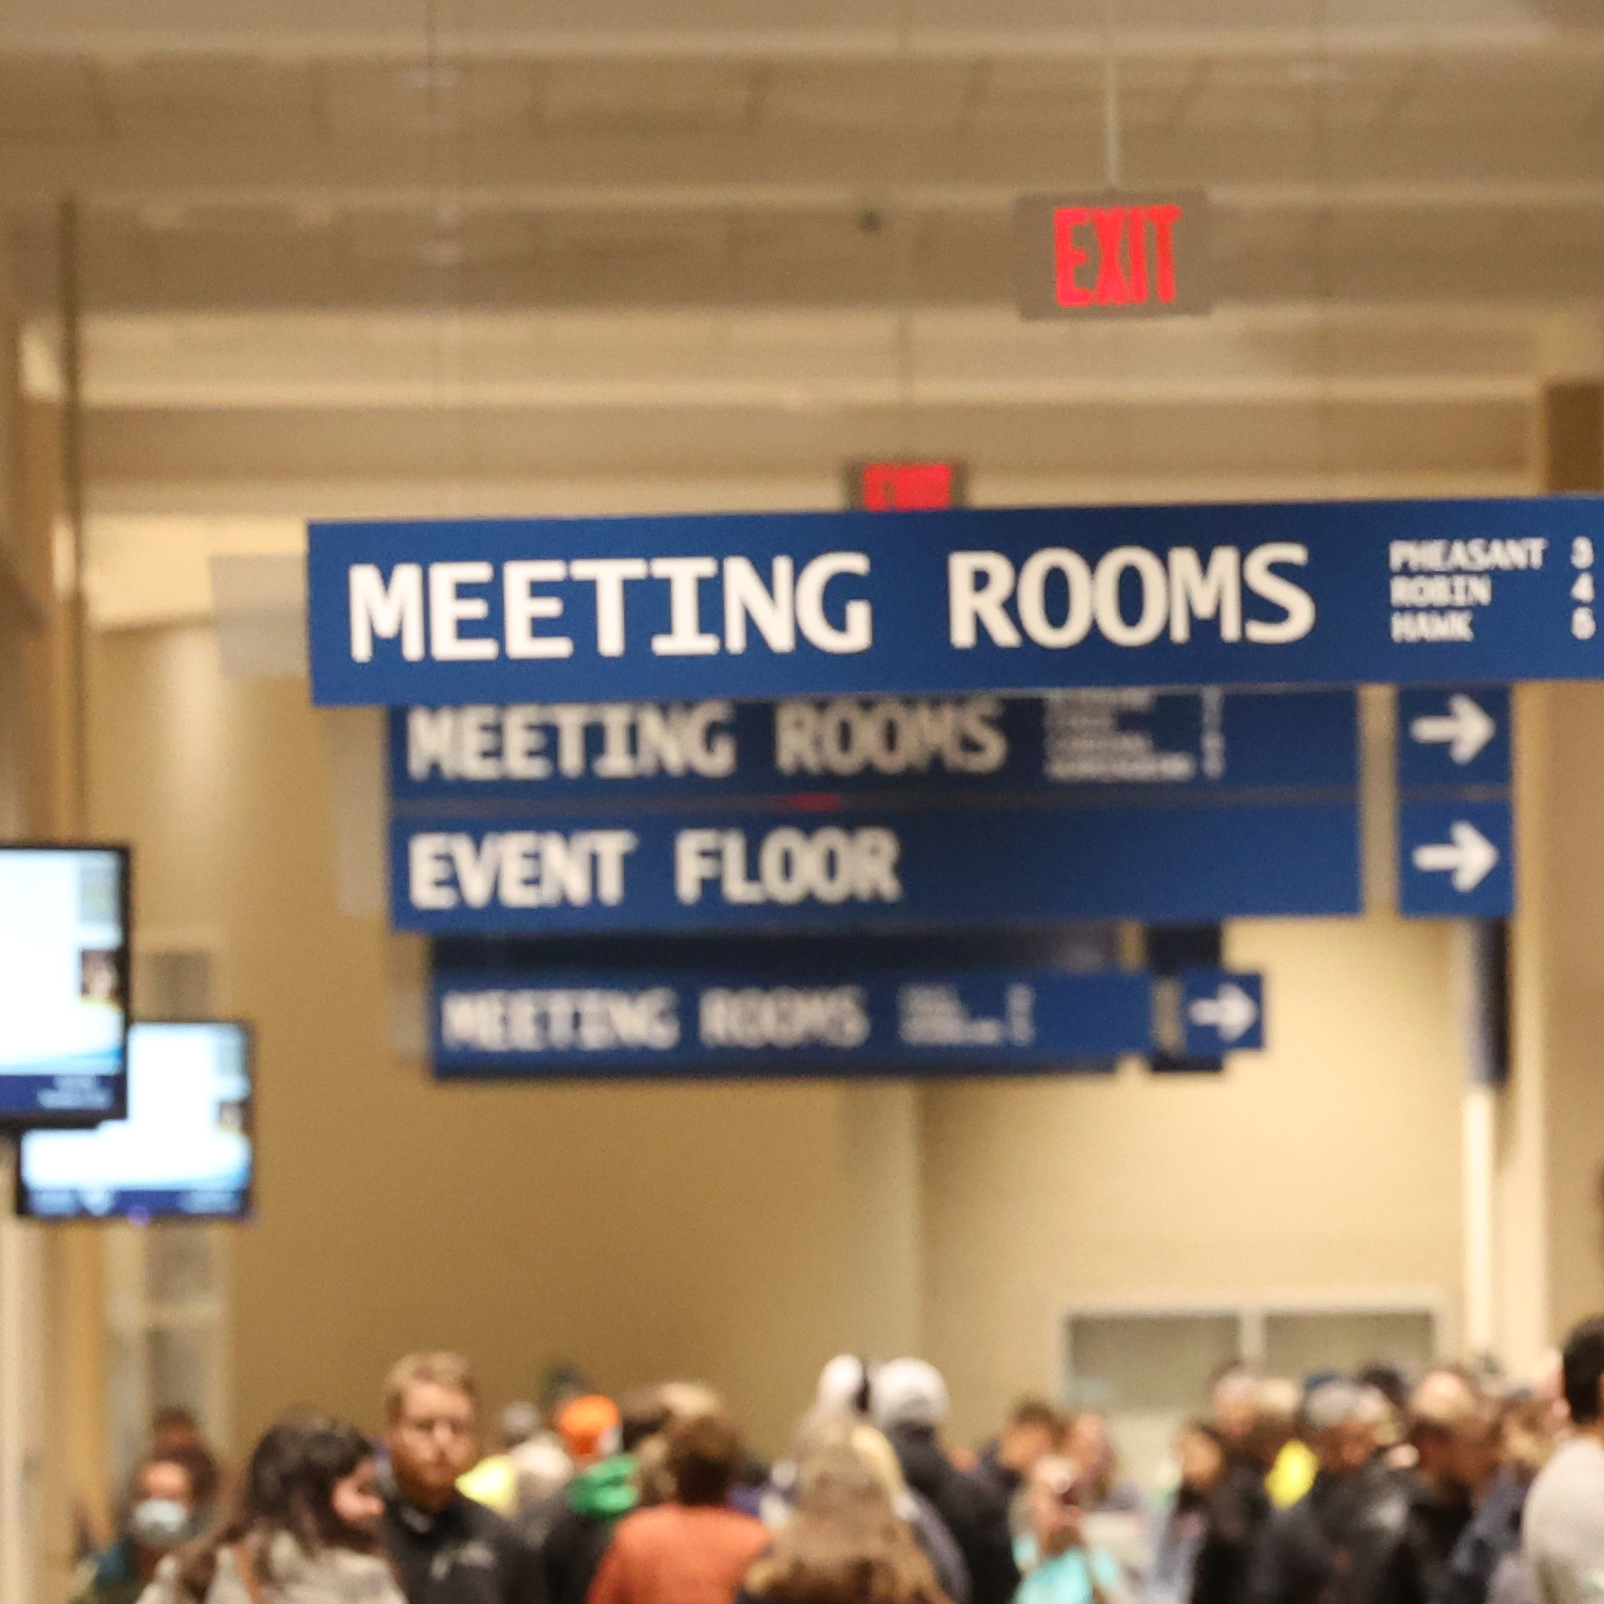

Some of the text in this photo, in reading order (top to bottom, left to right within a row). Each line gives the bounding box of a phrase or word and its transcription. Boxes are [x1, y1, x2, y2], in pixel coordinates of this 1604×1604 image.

[1054, 204, 1183, 307] EXIT
[1389, 537, 1548, 572] PHEASANT
[1390, 572, 1596, 607] ROBIN 4
[348, 541, 1317, 663] MEETING ROOMS
[407, 701, 737, 781] MEETING
[775, 695, 1009, 775] ROOMS
[408, 826, 904, 910] EVENT FLOOR
